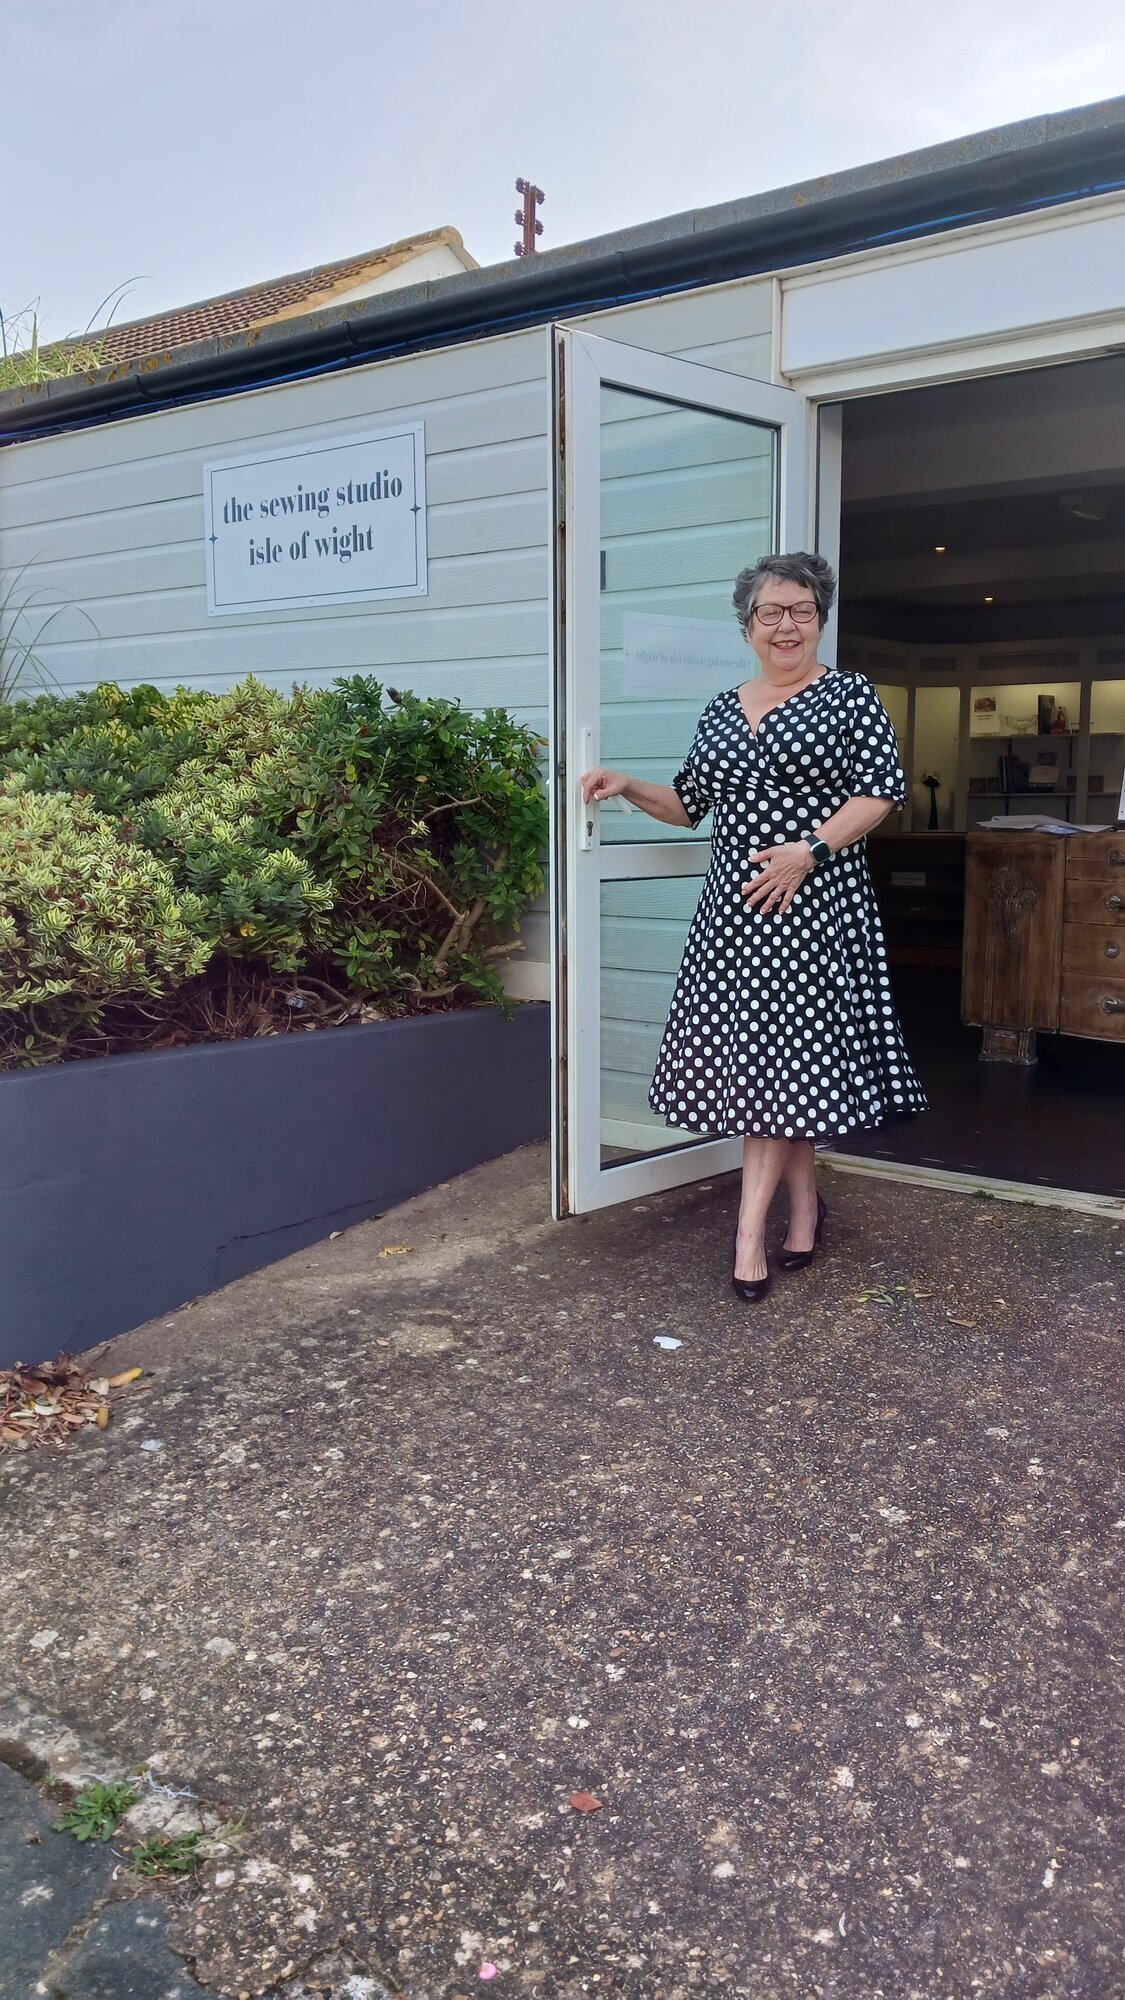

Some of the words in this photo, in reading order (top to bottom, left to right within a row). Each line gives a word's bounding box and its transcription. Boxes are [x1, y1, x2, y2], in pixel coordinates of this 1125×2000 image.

[223, 497, 253, 524] the
[260, 484, 330, 518] sewing
[336, 469, 403, 507] studio
[249, 538, 283, 566] isle
[289, 530, 310, 561] of
[314, 523, 374, 563] wight
